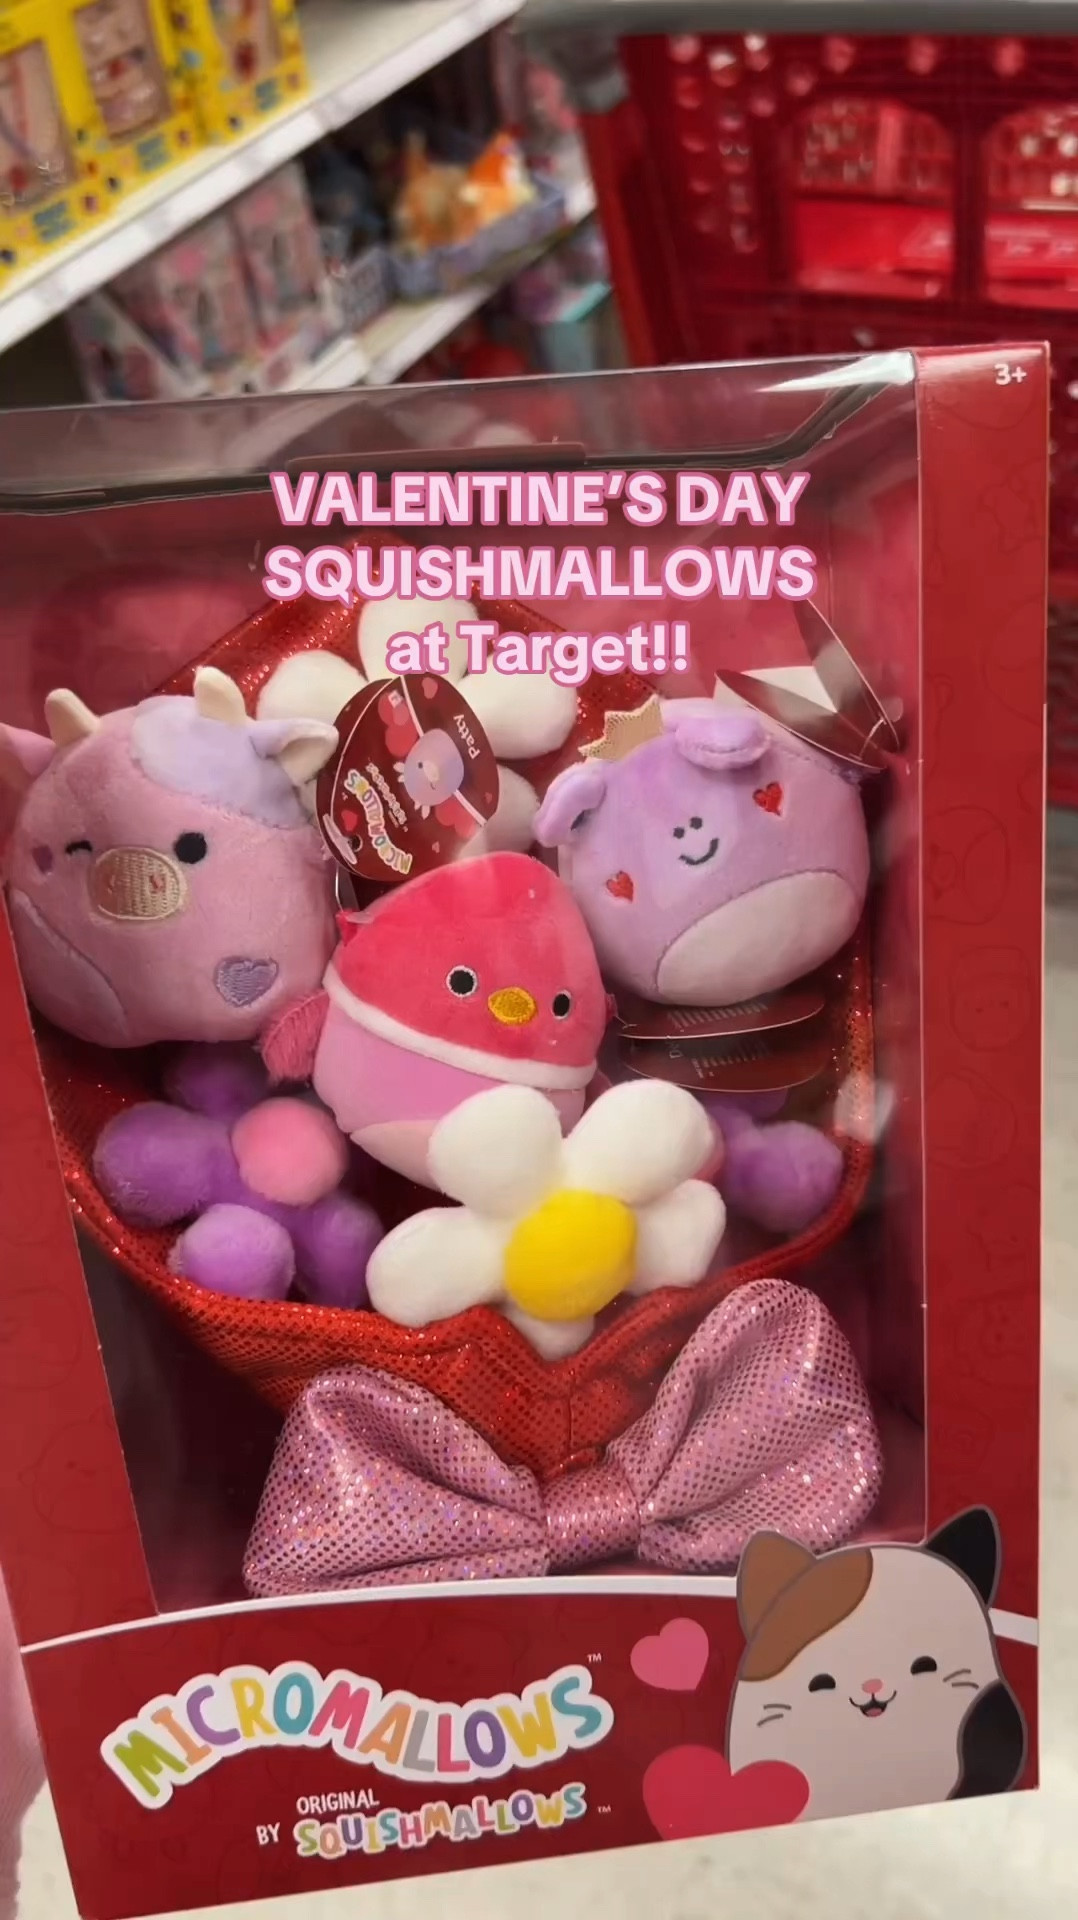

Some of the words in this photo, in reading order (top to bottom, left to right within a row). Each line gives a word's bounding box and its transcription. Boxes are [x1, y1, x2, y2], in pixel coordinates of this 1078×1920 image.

[994, 363, 1027, 386] 3+
[453, 714, 480, 759] Patty
[109, 1668, 606, 1800] MICROMALLOWS
[256, 1822, 280, 1845] BY
[295, 1784, 585, 1857] SQUISHMALLOWS
[296, 1788, 380, 1815] ORIGINAL
